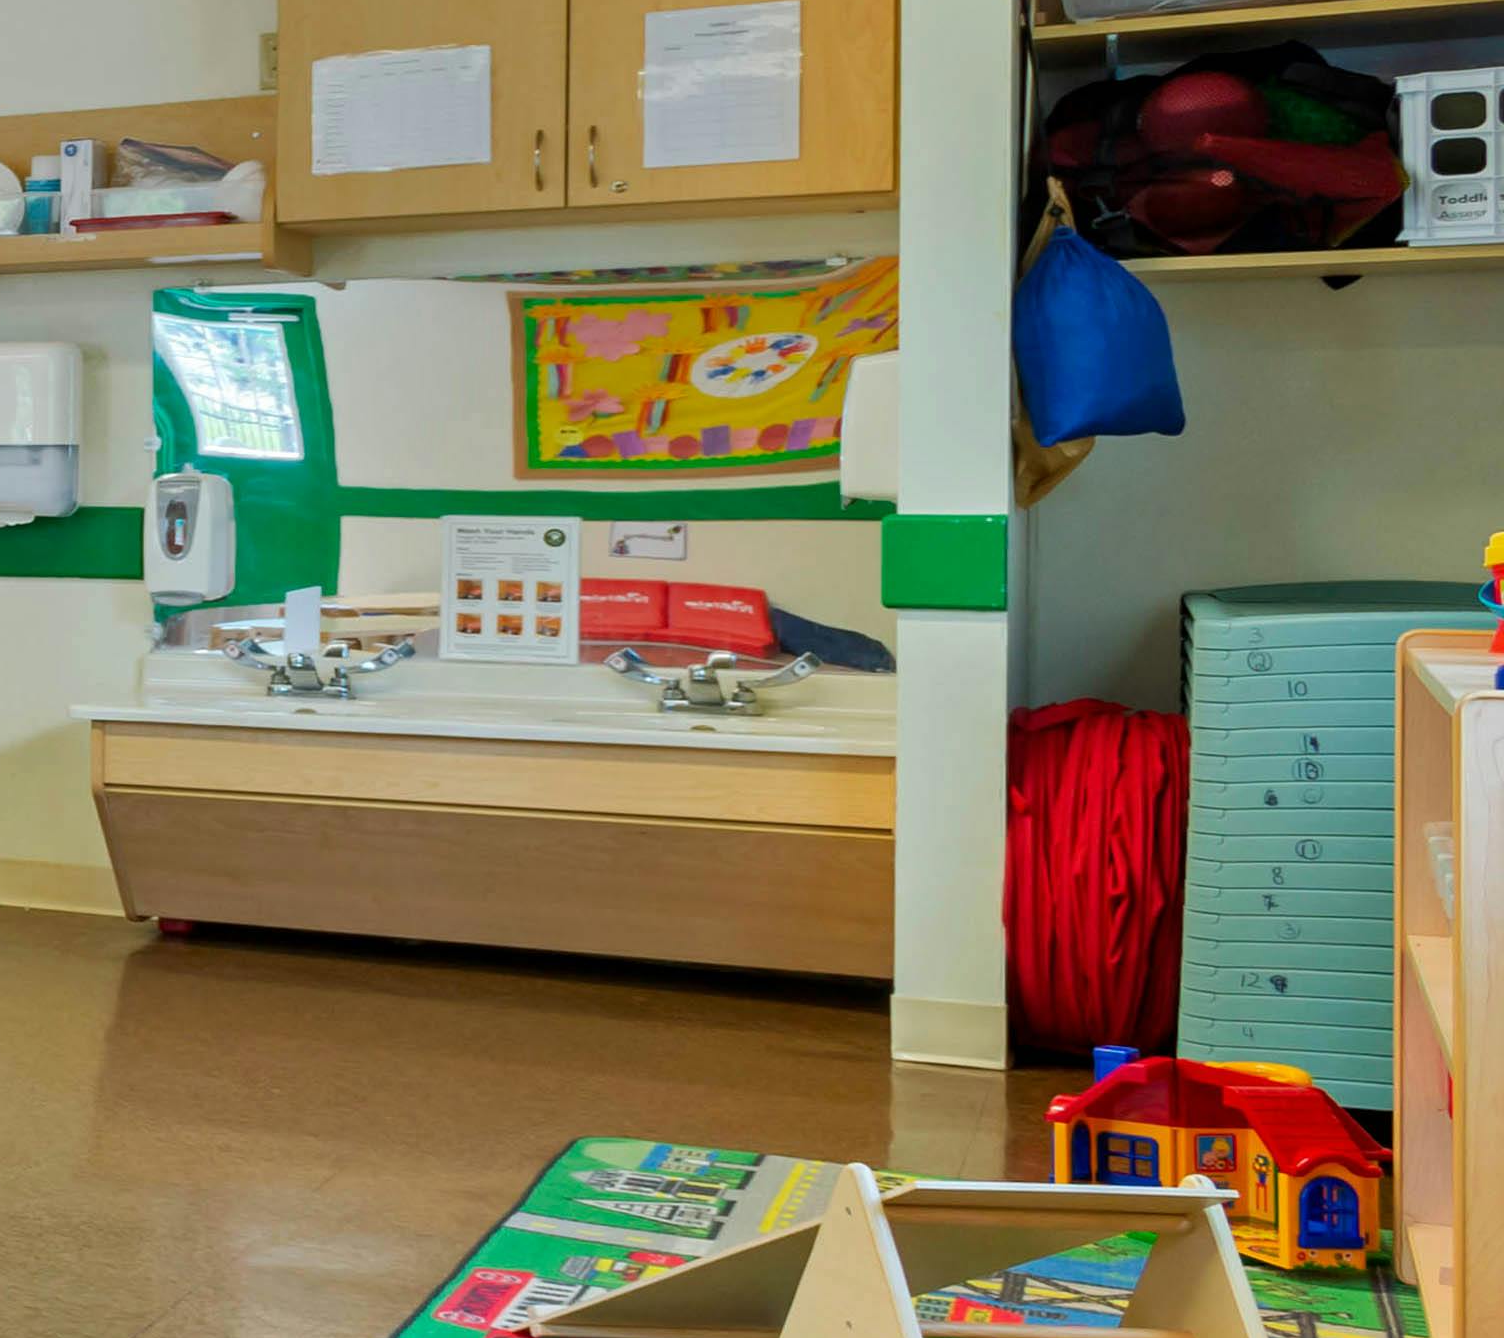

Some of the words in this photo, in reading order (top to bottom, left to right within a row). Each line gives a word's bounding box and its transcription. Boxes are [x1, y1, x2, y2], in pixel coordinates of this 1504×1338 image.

[1288, 680, 1308, 698] 10
[1272, 866, 1284, 885] 8
[1240, 972, 1263, 989] 12
